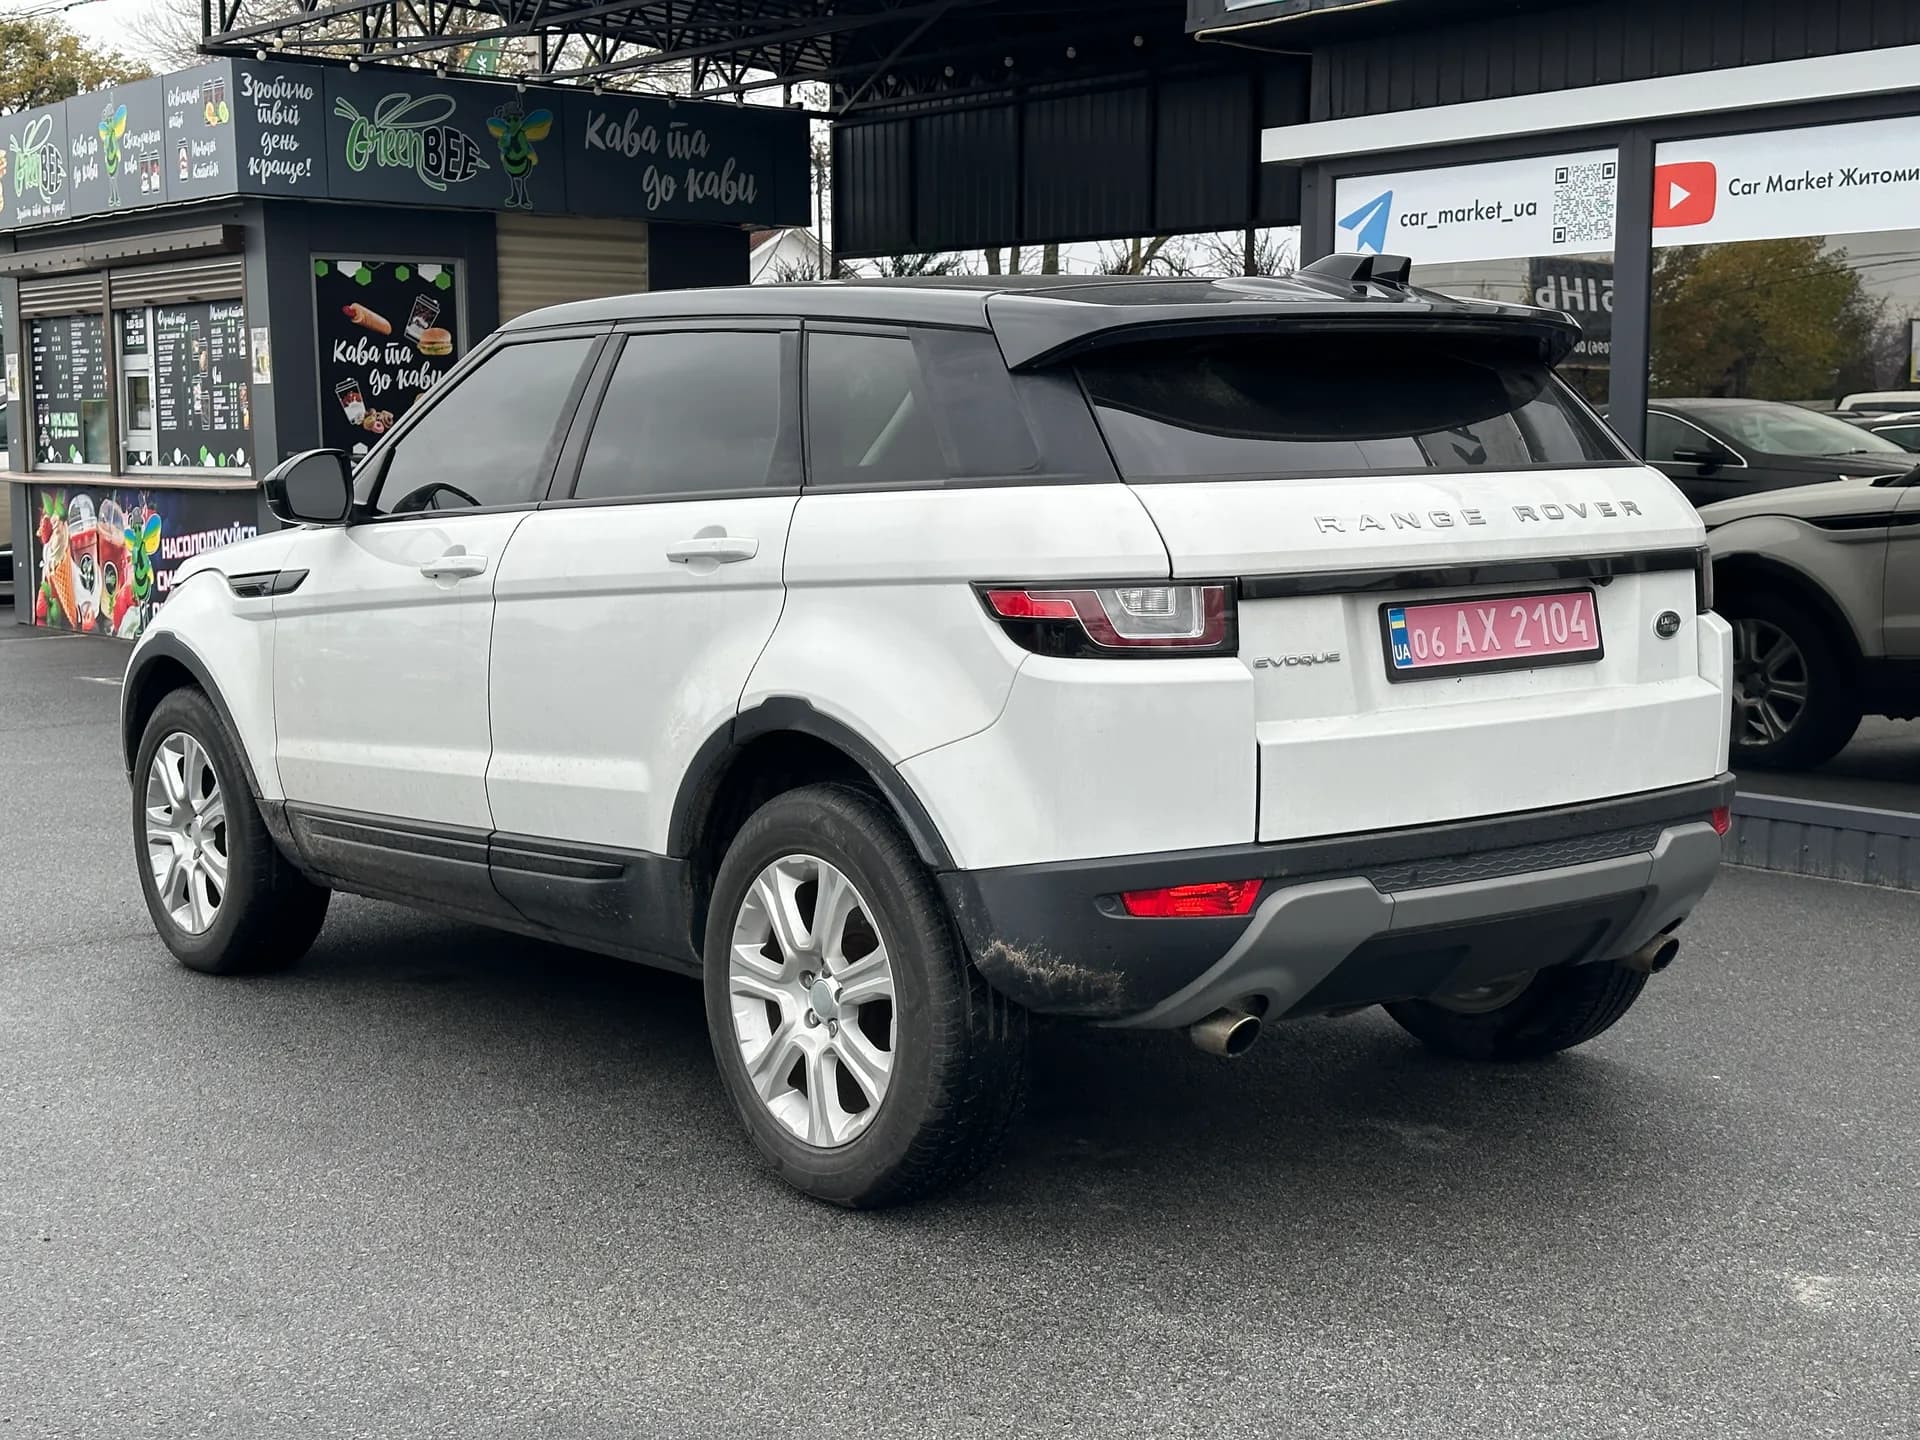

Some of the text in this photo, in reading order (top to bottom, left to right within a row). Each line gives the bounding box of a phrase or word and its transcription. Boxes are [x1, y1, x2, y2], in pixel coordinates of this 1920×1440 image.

[241, 72, 314, 106] Зробимо
[257, 99, 301, 126] твій
[261, 131, 300, 156] день
[585, 107, 710, 160] Кава та
[247, 156, 312, 185] краще!
[641, 157, 758, 211] до кави
[1728, 167, 1920, 197] Car Market Житоми
[1399, 199, 1538, 230] car_market_ua
[333, 336, 413, 366] Кава та
[369, 361, 443, 396] до кави
[1313, 500, 1643, 534] RANGE ROVER
[1413, 599, 1589, 659] 06 AX 2104
[1253, 651, 1341, 669] EVOQUE
[1394, 645, 1411, 661] UA
